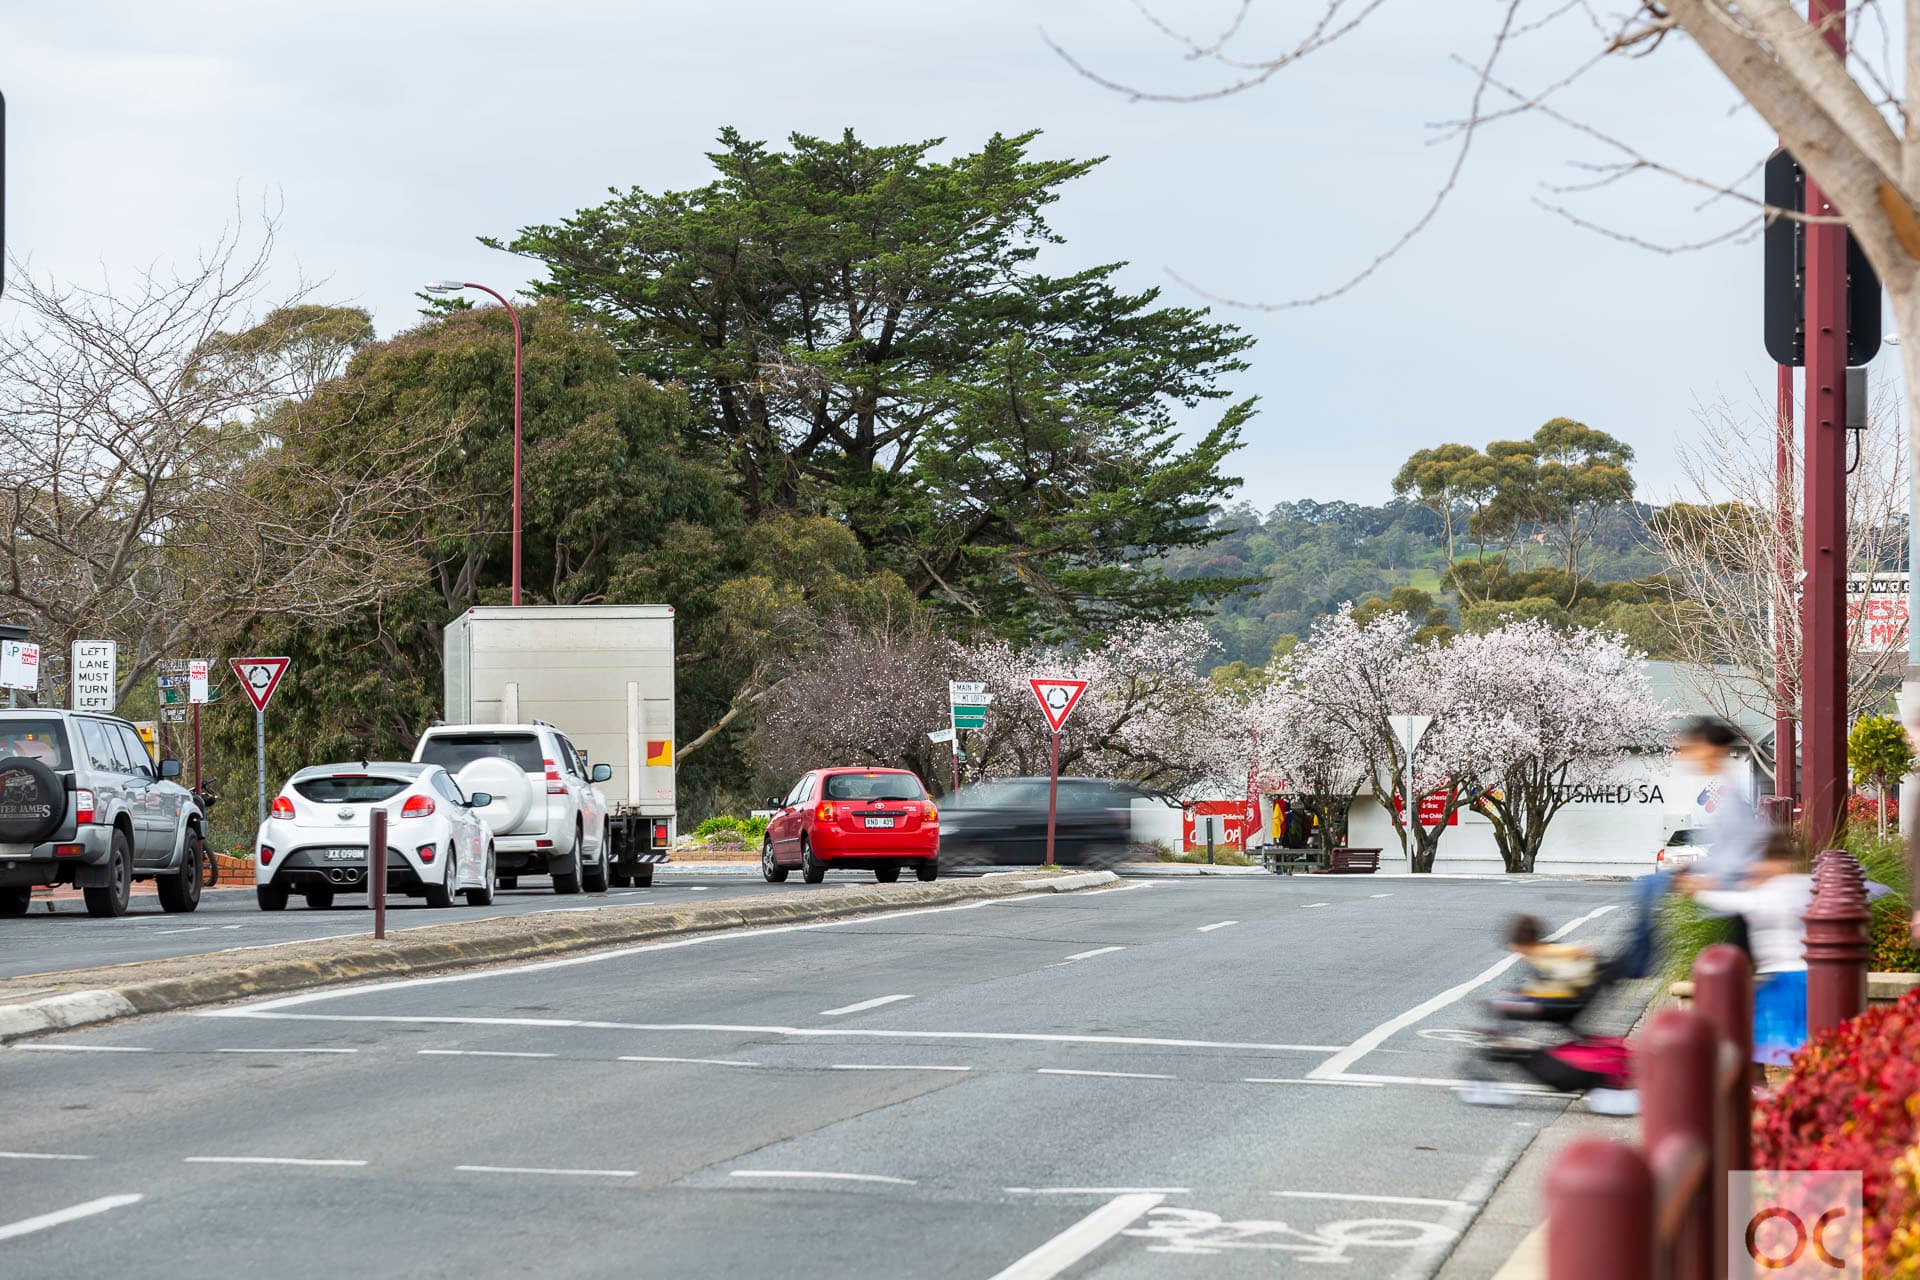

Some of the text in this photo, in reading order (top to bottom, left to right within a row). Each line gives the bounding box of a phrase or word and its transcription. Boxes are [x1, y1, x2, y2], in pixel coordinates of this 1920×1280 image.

[80, 647, 108, 656] LEFT
[79, 660, 109, 669] LANE
[79, 672, 109, 681] MUST
[79, 685, 108, 694] TURN
[956, 684, 972, 692] MAIN
[80, 697, 108, 707] LEFT
[971, 694, 987, 703] LOFTY
[1638, 784, 1665, 804] SA
[20, 804, 51, 818] JAMES
